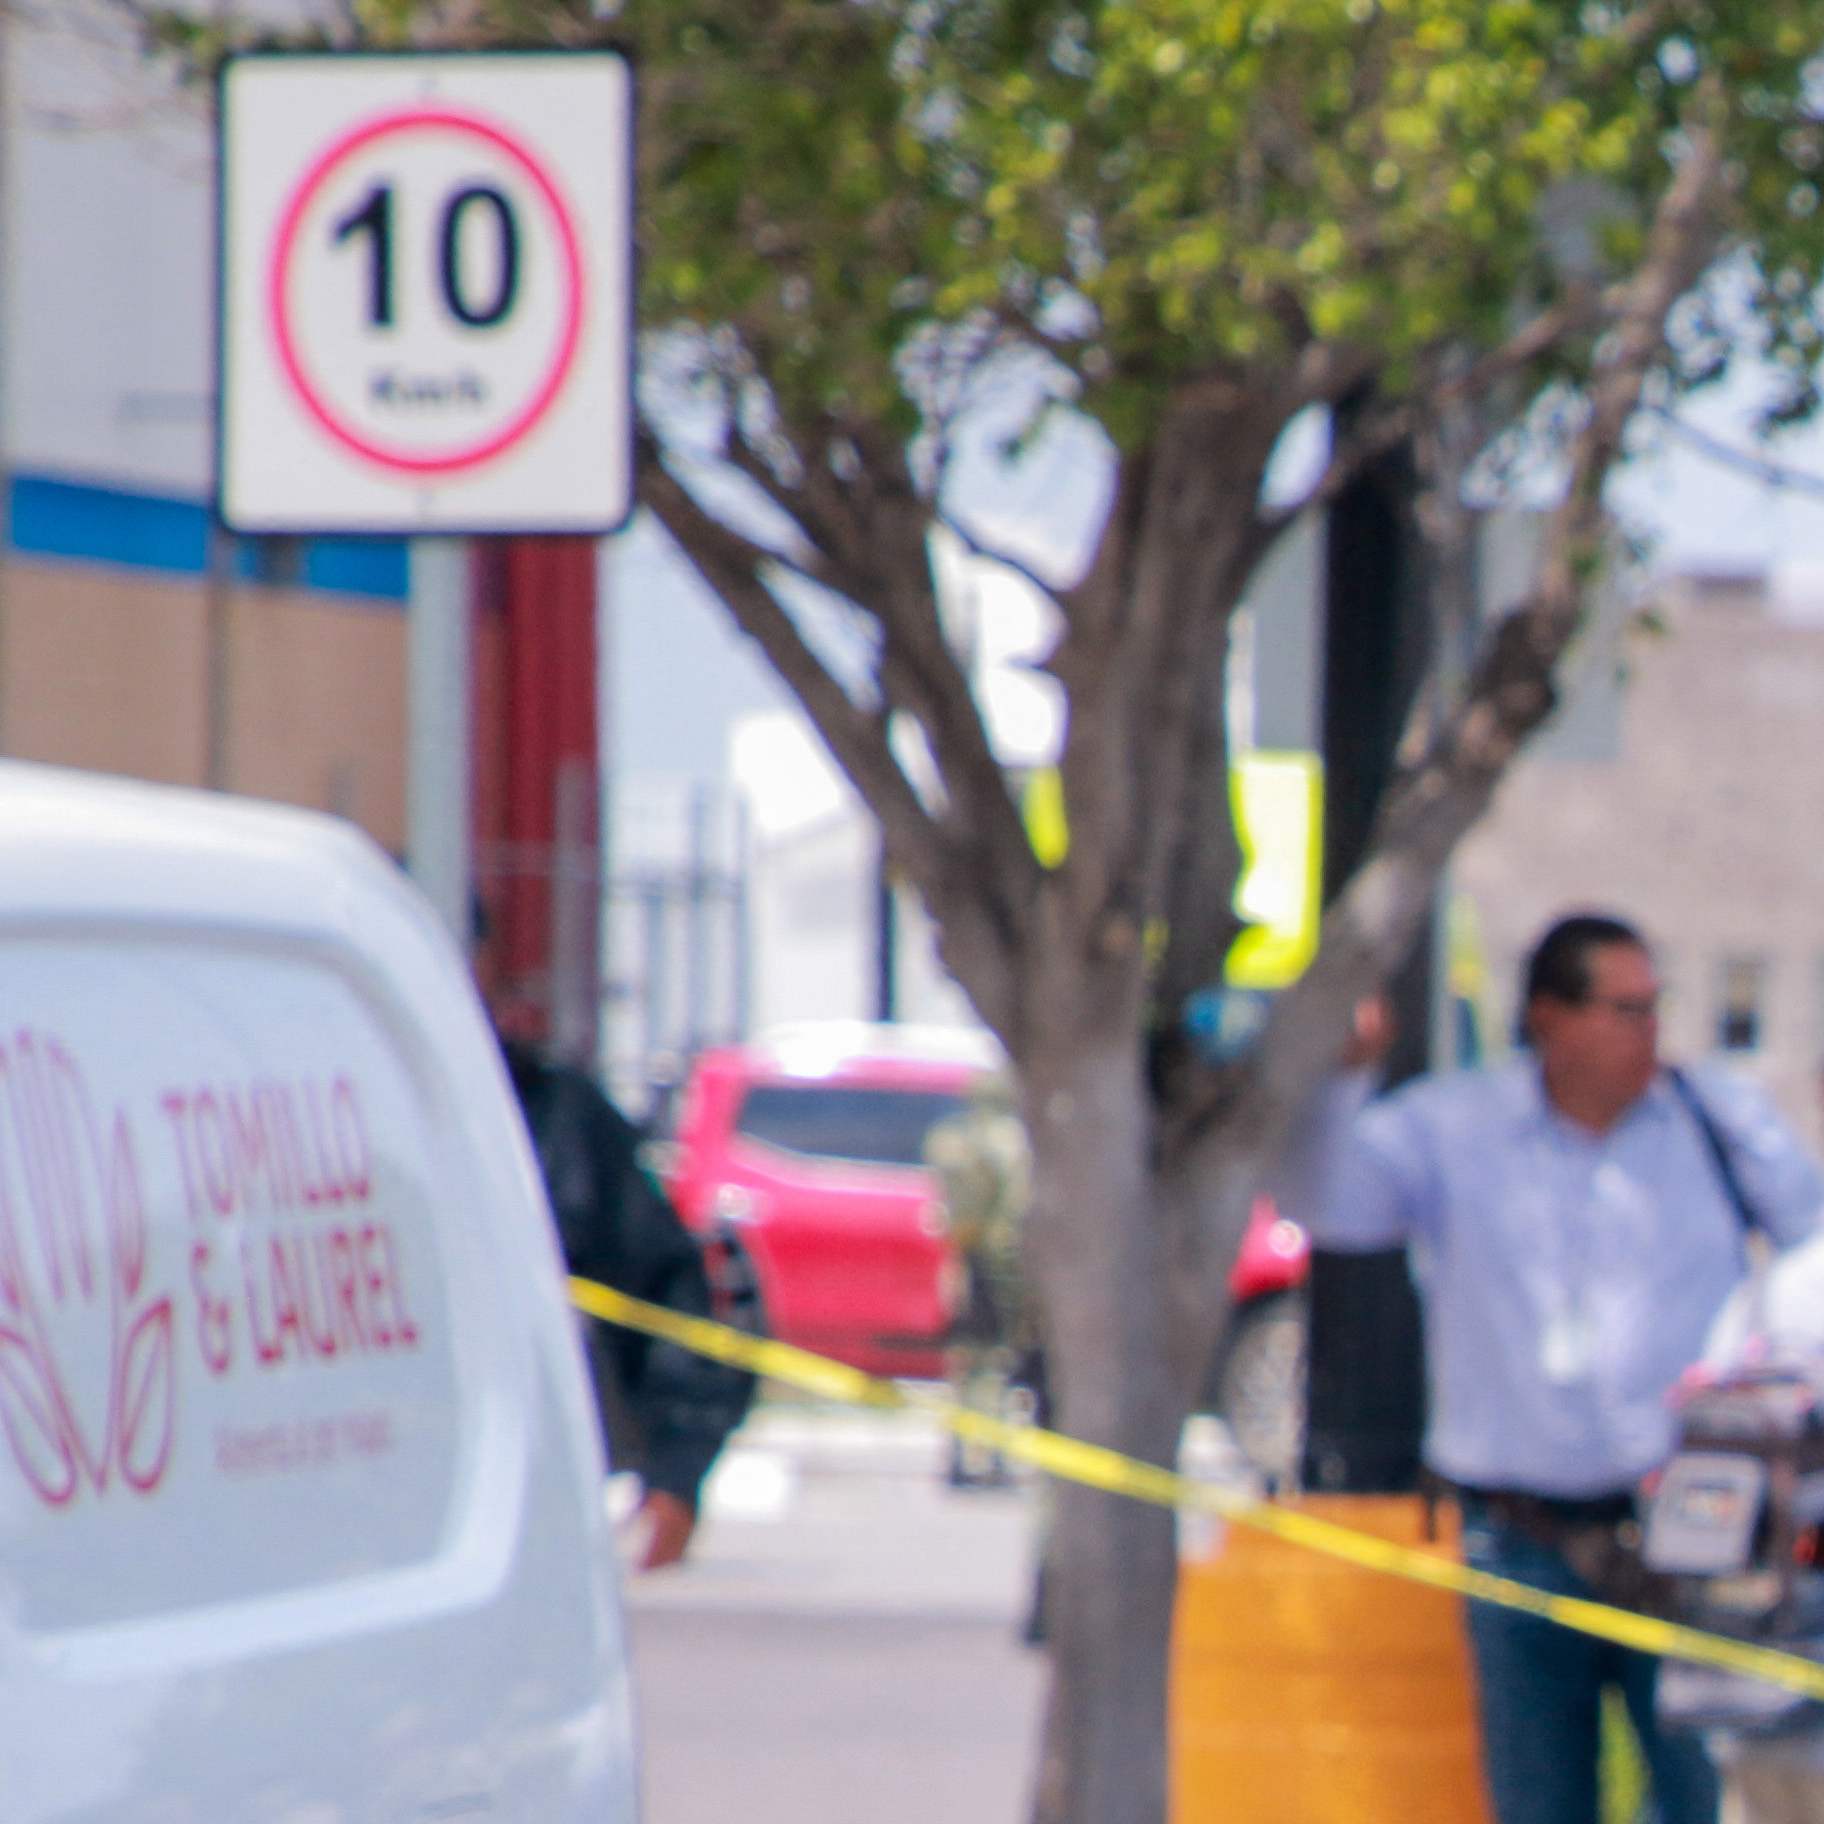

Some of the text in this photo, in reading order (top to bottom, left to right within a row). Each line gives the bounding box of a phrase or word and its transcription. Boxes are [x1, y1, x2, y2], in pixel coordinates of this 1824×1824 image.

[335, 185, 520, 327] 10
[160, 1074, 371, 1216] TOMILLO
[187, 1220, 420, 1376] & LAUREL
